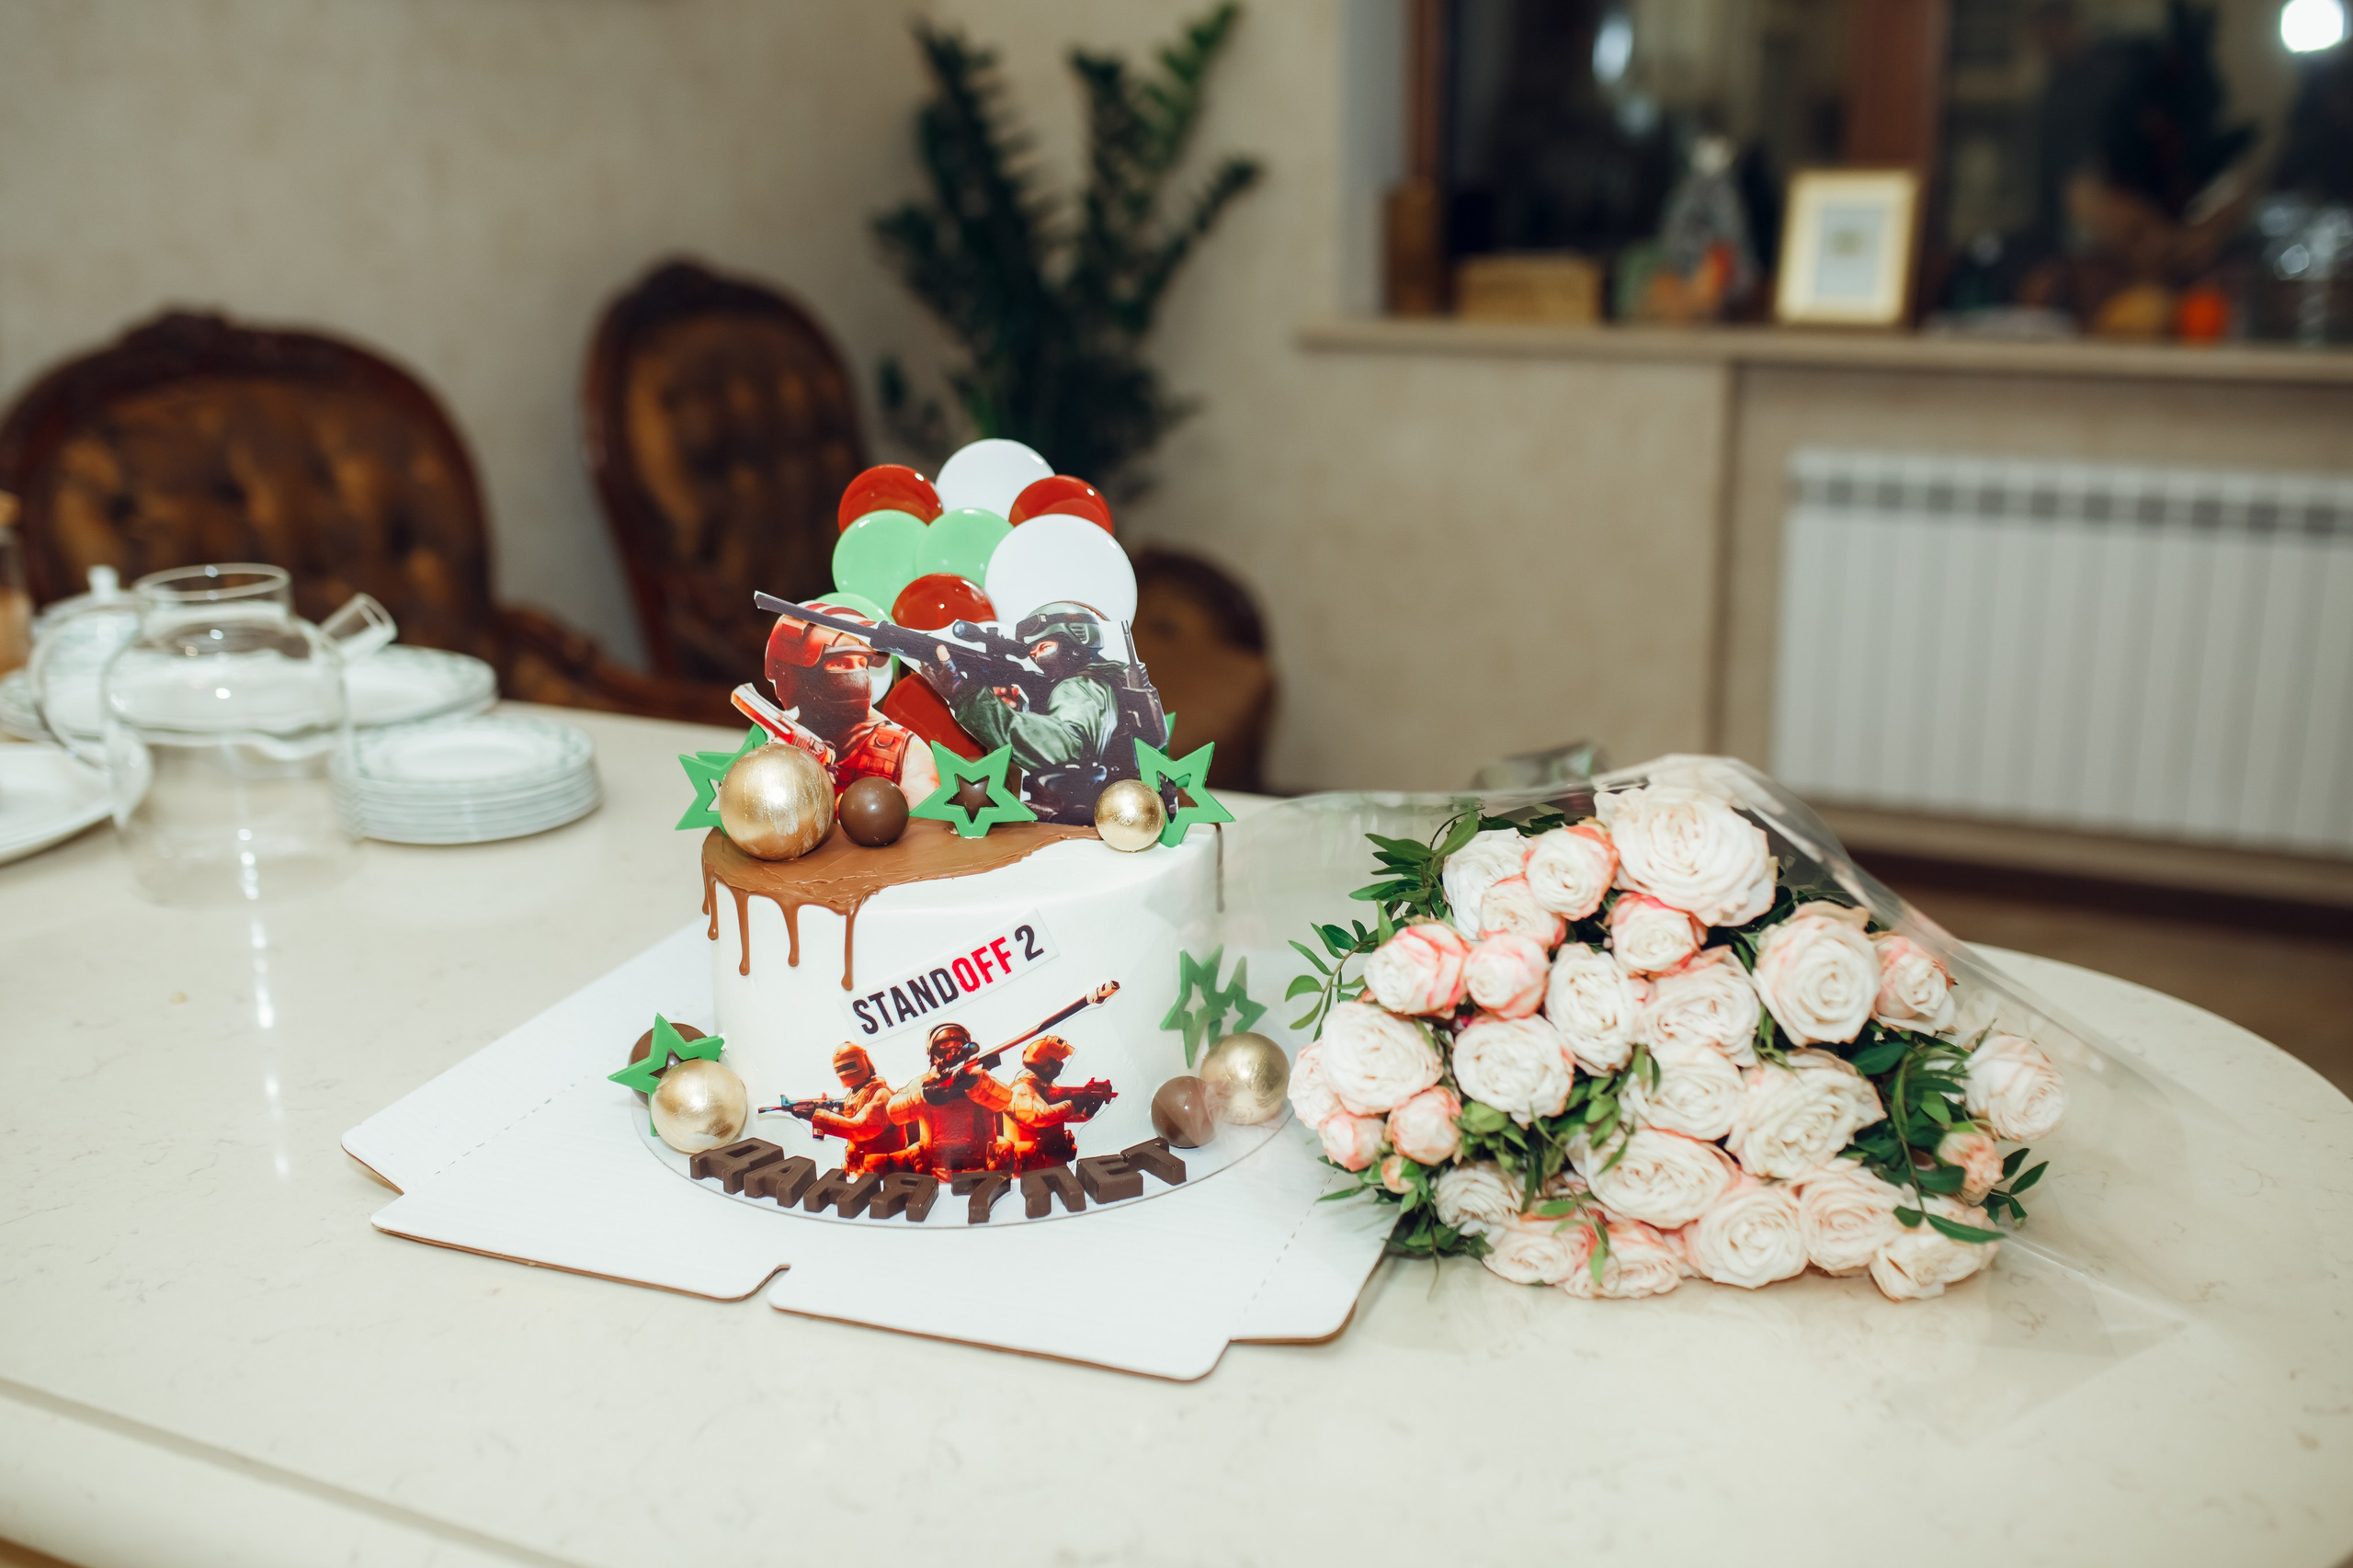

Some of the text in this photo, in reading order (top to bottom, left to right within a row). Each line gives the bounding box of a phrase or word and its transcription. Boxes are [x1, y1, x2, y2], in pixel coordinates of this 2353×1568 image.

[852, 925, 1045, 1035] STANDOFF 2
[689, 1137, 1188, 1224] ДАНЯ 7 ЛЕТ
